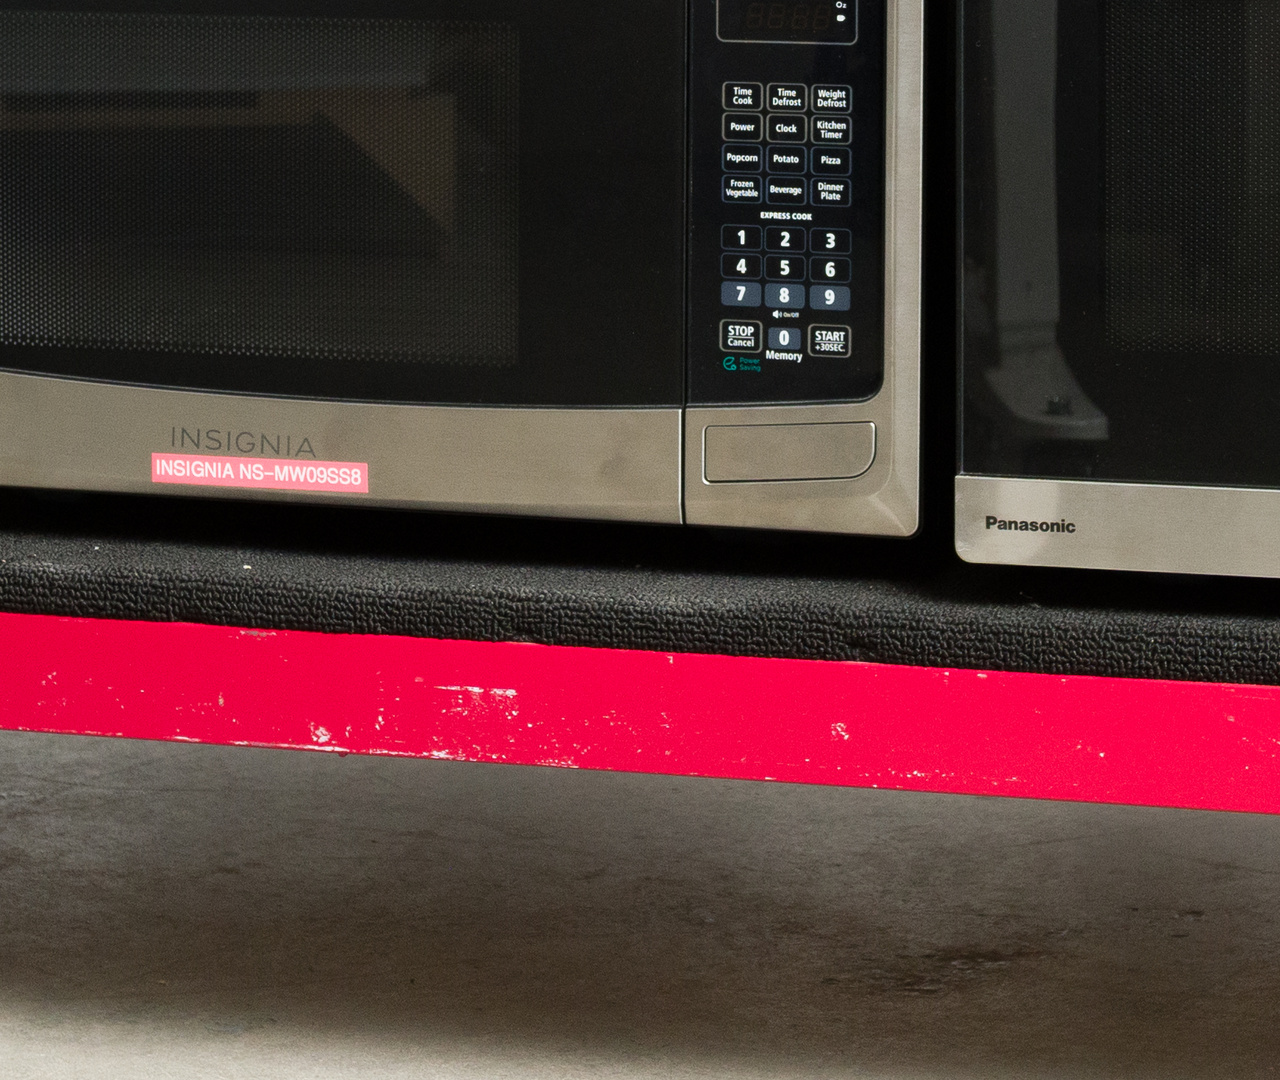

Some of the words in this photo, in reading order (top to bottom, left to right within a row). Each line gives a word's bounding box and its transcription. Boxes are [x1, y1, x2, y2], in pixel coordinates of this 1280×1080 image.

[835, 1, 847, 9] Oz
[733, 87, 753, 96] Time
[777, 88, 797, 97] Time
[818, 89, 846, 99] Weight
[732, 96, 753, 105] Cook
[772, 97, 802, 107] Defrost
[817, 99, 847, 108] Defrost
[730, 122, 755, 131] Power
[775, 124, 797, 133] Clock
[817, 121, 847, 130] Kitchen
[820, 130, 843, 139] Timer
[726, 152, 758, 163] Popcorn
[773, 154, 799, 164] Potato
[820, 155, 841, 165] Pizza
[730, 179, 754, 188] Frozen
[818, 182, 844, 192] Dinner
[726, 188, 759, 199] Vegetable
[769, 185, 802, 195] Beverage
[820, 192, 841, 201] Plate
[760, 211, 791, 220] EXPRESS
[791, 213, 813, 221] COOK
[737, 230, 746, 245] 1
[780, 231, 791, 247] 2
[825, 233, 836, 249] 3
[736, 258, 747, 274] 4
[779, 260, 790, 276] 5
[825, 261, 836, 277] 6
[736, 286, 746, 301] 7
[779, 287, 790, 303] 8
[824, 289, 835, 305] 9
[727, 326, 755, 336] STOP
[778, 330, 790, 346] 0
[815, 331, 846, 342] START
[727, 338, 755, 347] Cancel
[815, 343, 846, 352] +30SEC.
[739, 357, 760, 365] Power
[765, 350, 803, 363] Memory
[739, 364, 761, 373] Saving
[171, 426, 317, 458] INSIGNIA
[156, 459, 235, 479] INSIGNIA
[239, 463, 363, 486] NS-MW09SS8
[985, 515, 1076, 534] Panasonic
